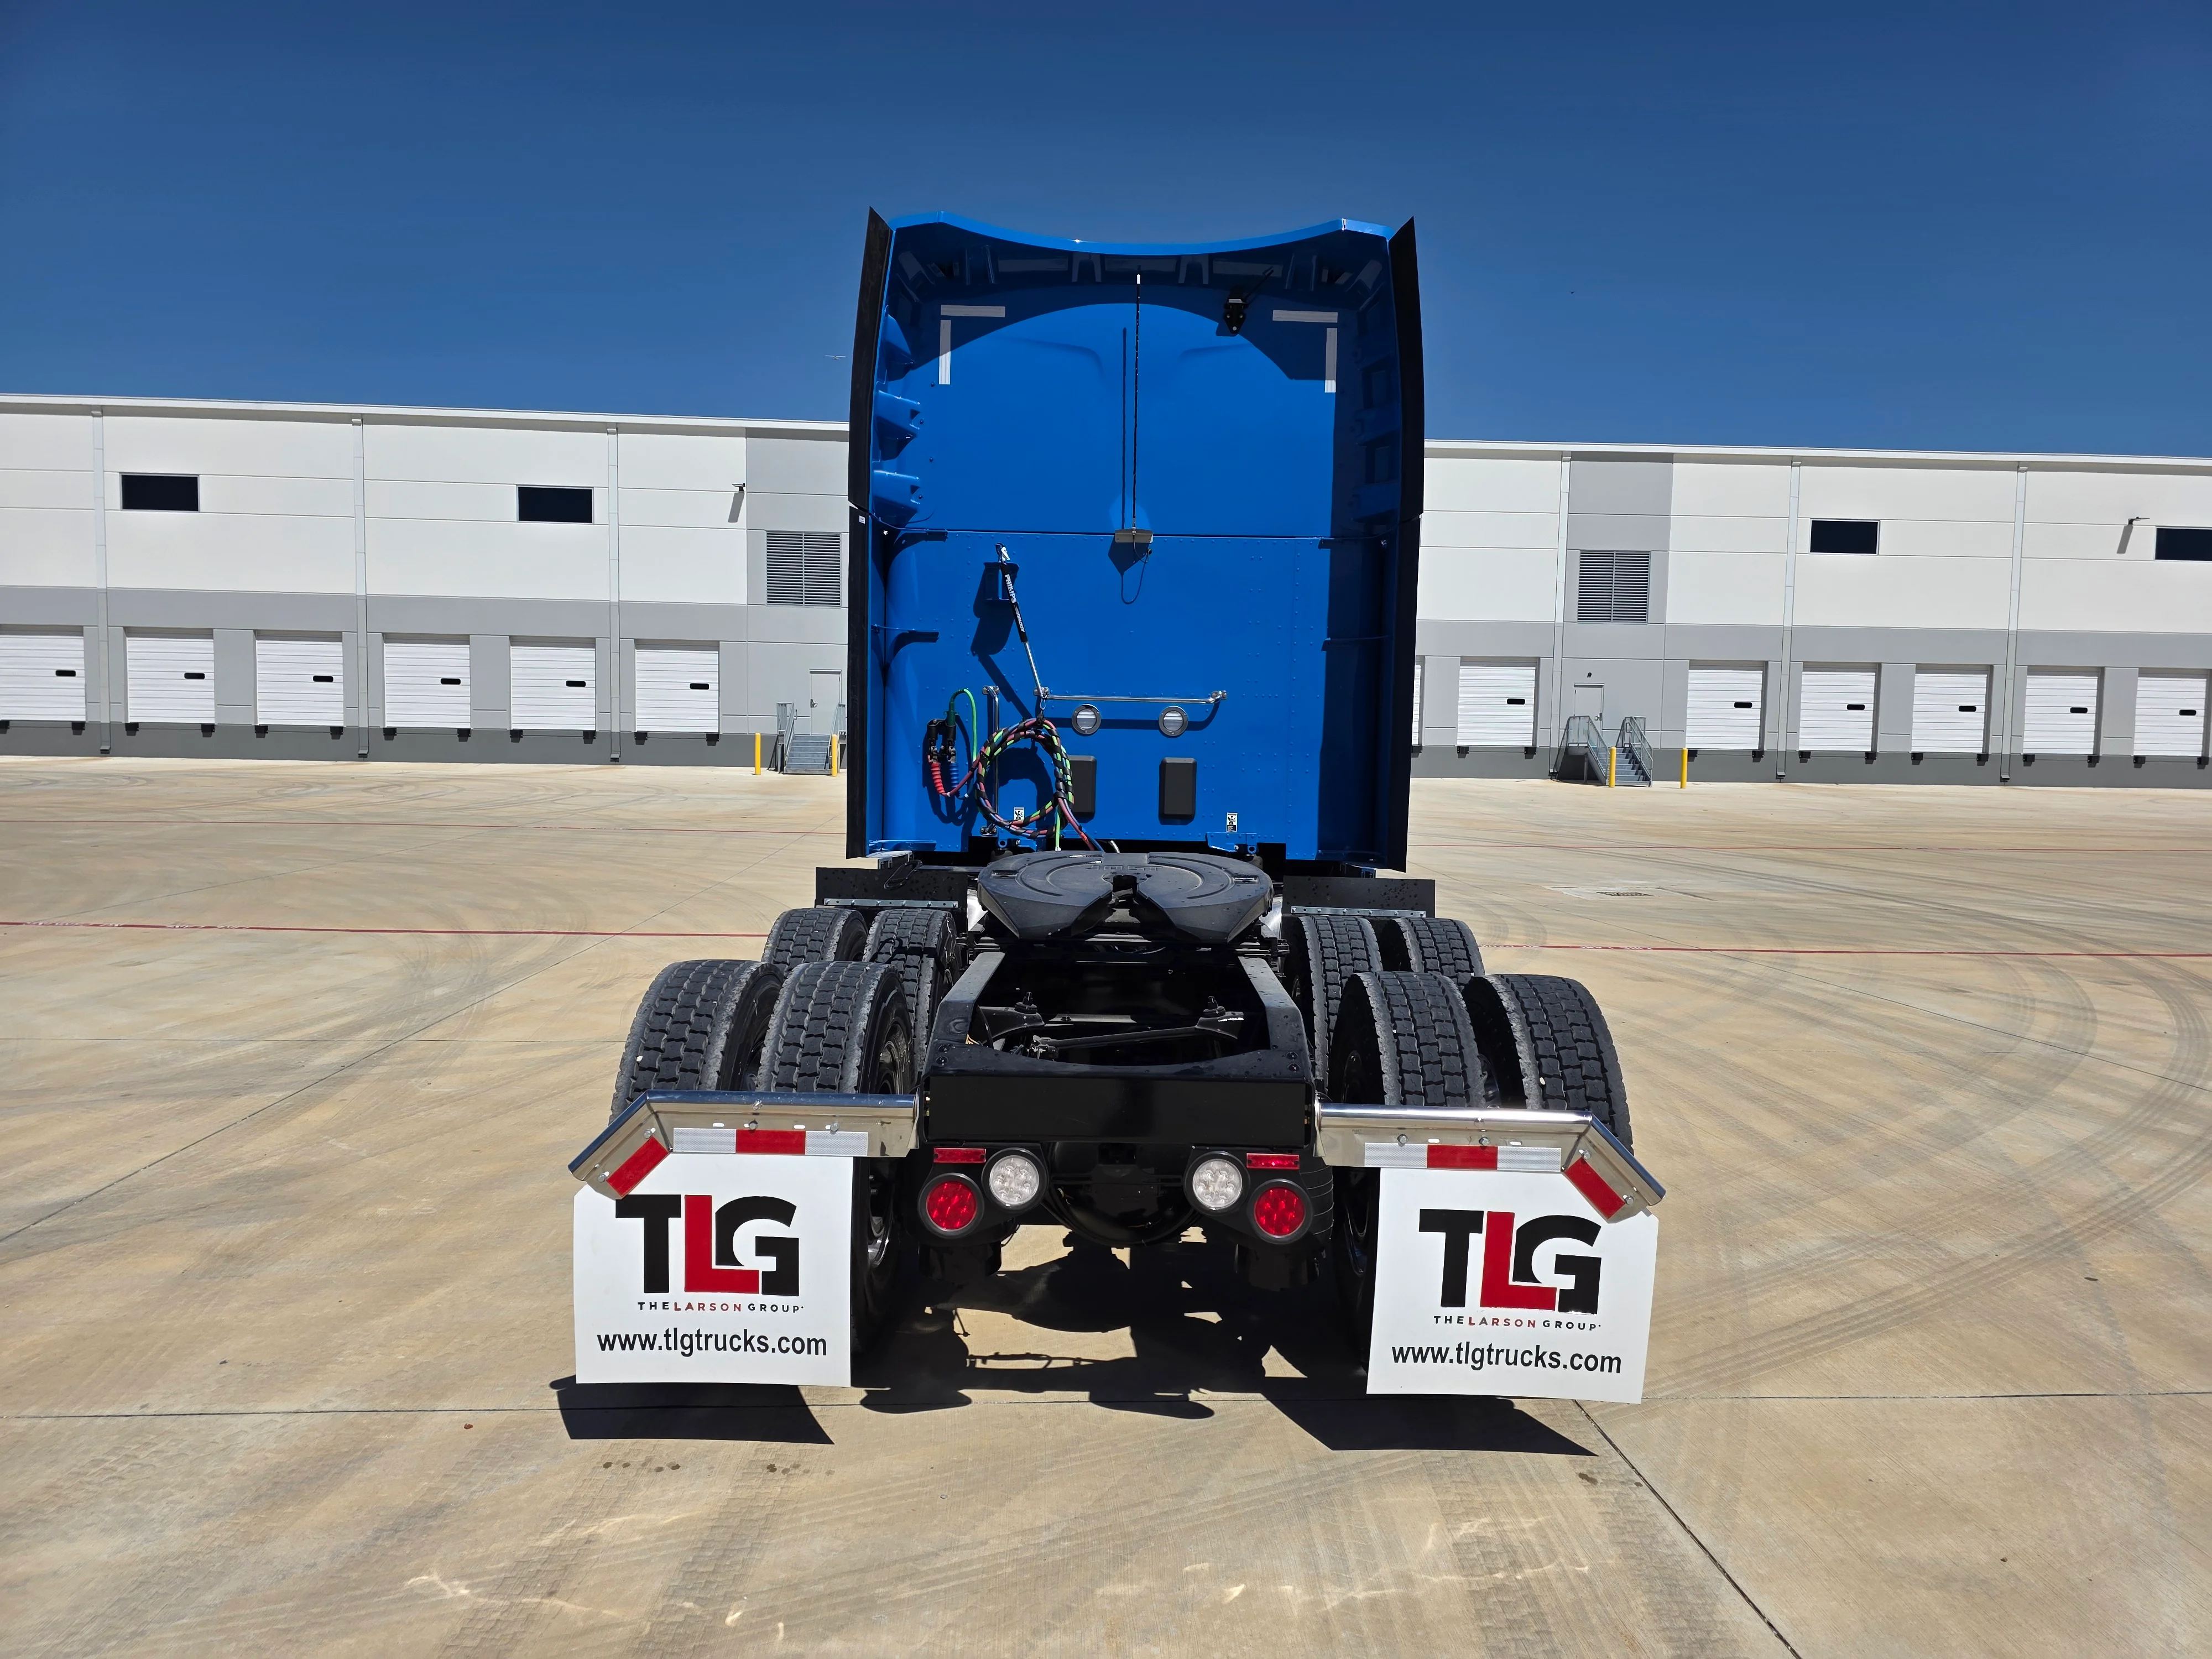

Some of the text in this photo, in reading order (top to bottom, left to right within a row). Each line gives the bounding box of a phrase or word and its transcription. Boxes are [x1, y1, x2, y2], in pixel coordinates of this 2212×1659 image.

[1004, 574, 1017, 603] PHILLIPS
[615, 1194, 800, 1297] TLG
[1418, 1208, 1602, 1315] TLG
[748, 1303, 800, 1313] GROUP
[1542, 1319, 1597, 1331] GROUP
[597, 1327, 827, 1357] www.tlgtrucks.com
[1391, 1341, 1621, 1374] www.tlgtrucks.com
